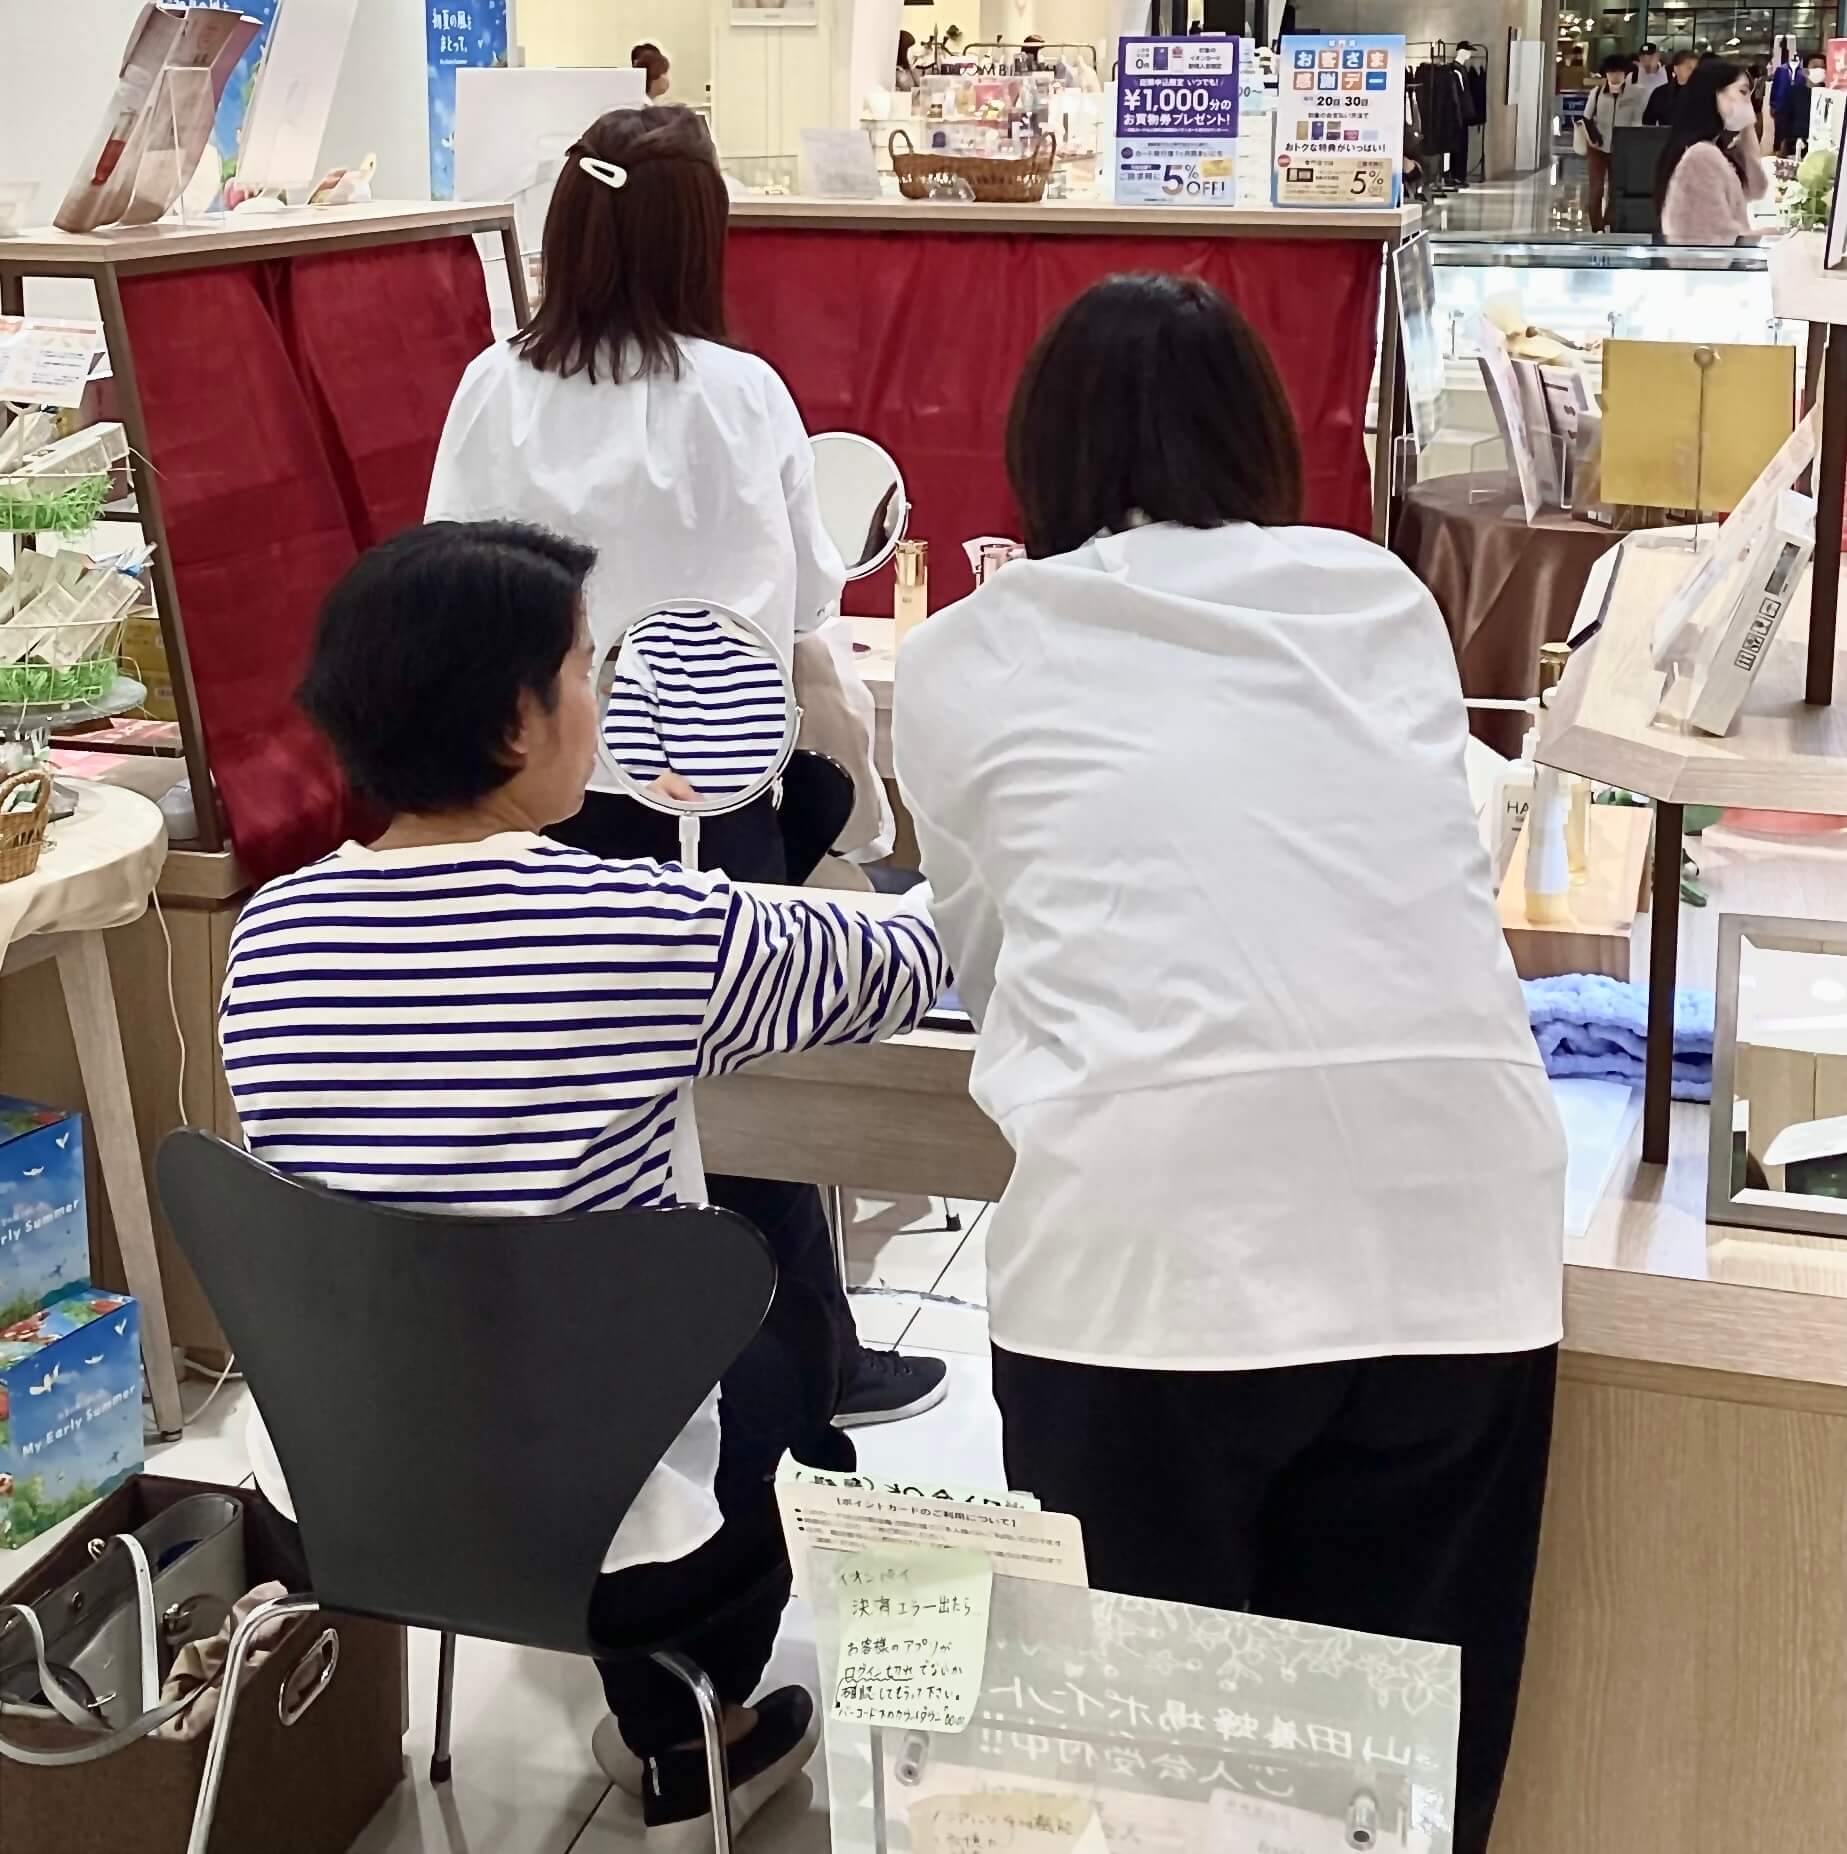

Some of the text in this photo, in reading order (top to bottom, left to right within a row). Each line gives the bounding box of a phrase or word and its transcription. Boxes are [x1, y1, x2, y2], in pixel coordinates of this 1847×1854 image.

[1123, 89, 1232, 111] ¥1,000分の
[1123, 113, 1231, 126] お買物券プレゼント!
[1285, 143, 1386, 152] おトクな特典がいっぱい!
[25, 1200, 79, 1233] Summer
[22, 1440, 42, 1457] My
[46, 1417, 83, 1445] Early
[86, 1384, 136, 1422] Summer
